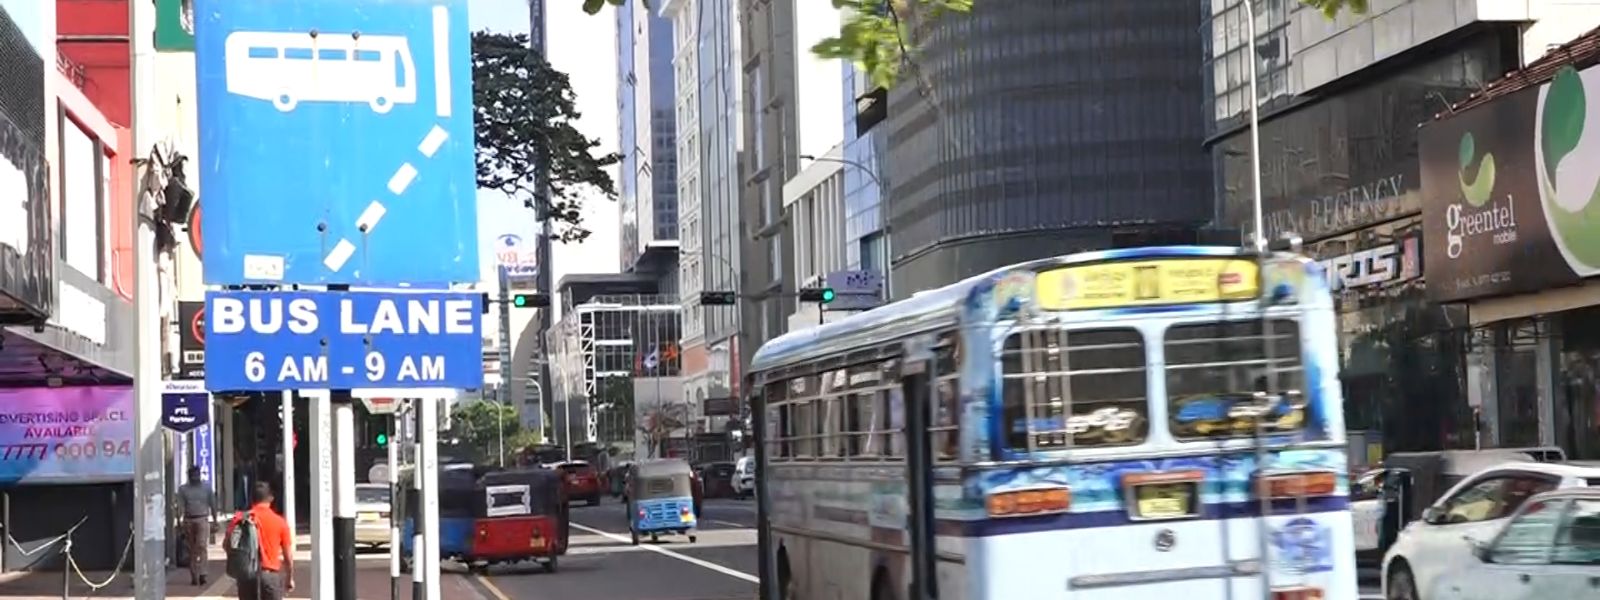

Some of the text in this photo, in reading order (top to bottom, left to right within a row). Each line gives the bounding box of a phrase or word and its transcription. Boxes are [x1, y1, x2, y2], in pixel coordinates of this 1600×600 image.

[1311, 174, 1403, 234] REGENCY
[1446, 193, 1516, 258] greentel
[213, 299, 474, 334] BUS LANE
[245, 352, 266, 382] 6
[278, 356, 328, 381] AM
[365, 351, 385, 382] 9
[397, 355, 445, 381] AM
